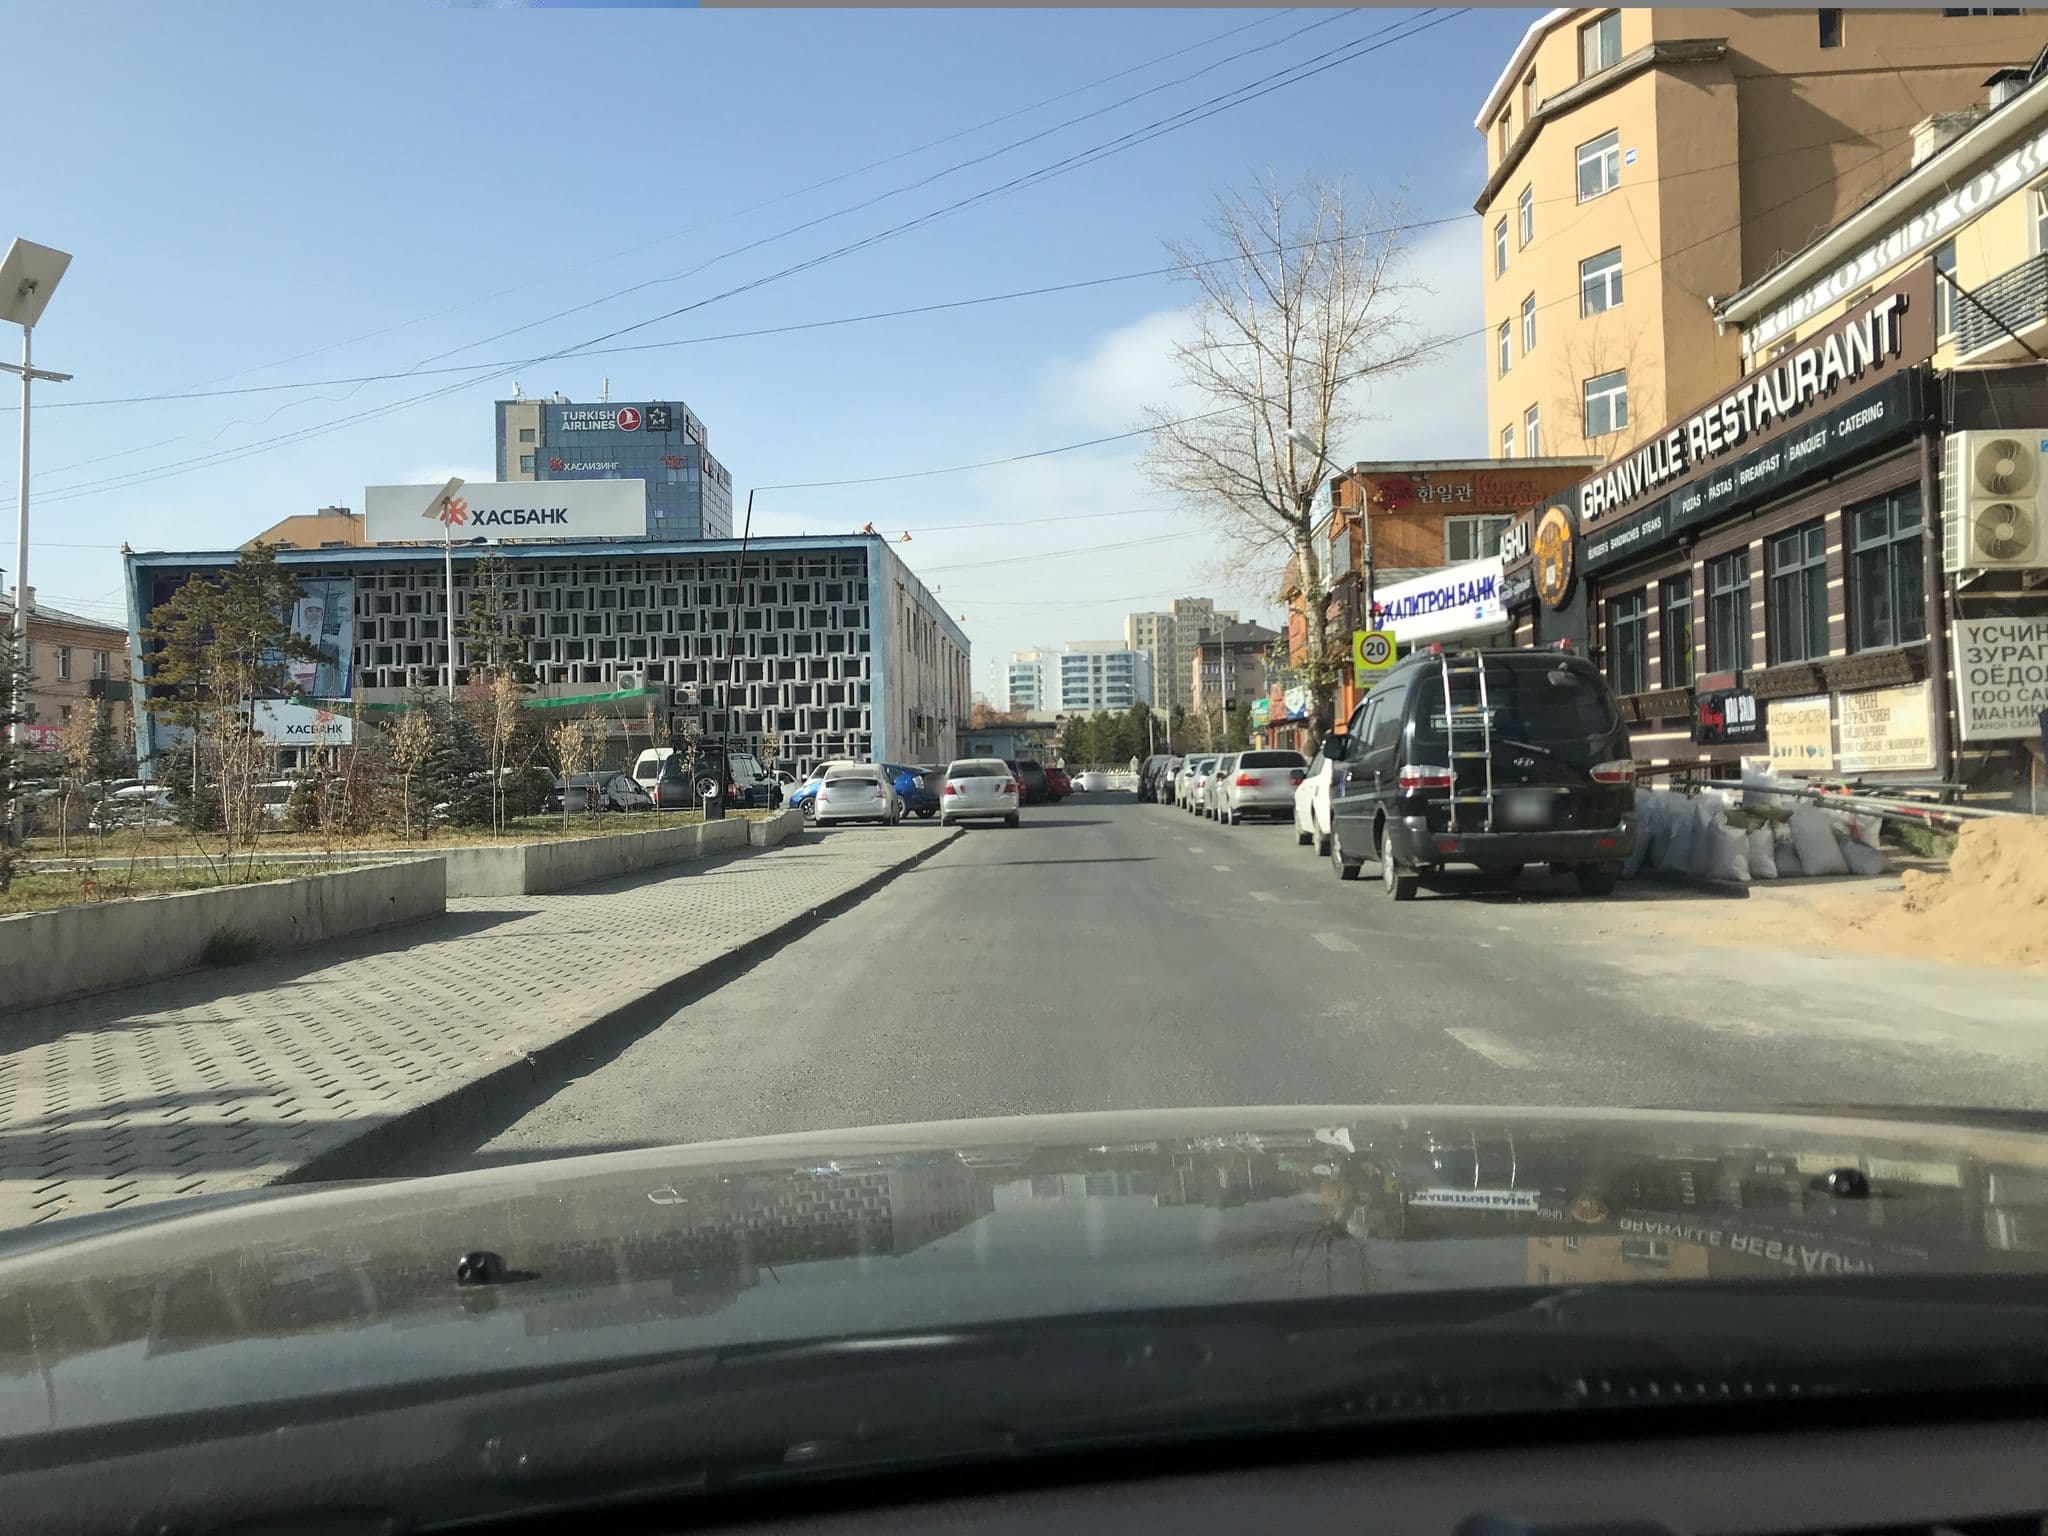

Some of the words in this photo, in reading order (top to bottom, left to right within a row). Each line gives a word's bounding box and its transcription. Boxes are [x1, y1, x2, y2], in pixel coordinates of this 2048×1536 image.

[1581, 430, 1683, 519] GRANVILLE
[1687, 293, 1898, 461] RESTAURANT
[562, 411, 616, 420] TURKISH
[562, 420, 616, 430] AIRLINES
[1682, 493, 1701, 514] PIZZAS
[1708, 477, 1733, 503] PASTAS
[1739, 453, 1781, 485] BREAKFAST
[1789, 430, 1827, 461] BANQUET
[1838, 401, 1884, 437] CATERING
[1417, 483, 1474, 503] 한일관
[471, 508, 569, 526] ХАСБАНК
[1386, 585, 1456, 622] КАПИТРОН
[1458, 574, 1497, 606] БАНК
[1366, 642, 1386, 656] 20
[1970, 664, 2048, 688] ОЁДО
[1971, 689, 2011, 704] ГОО
[1973, 703, 2047, 720] МАНИК
